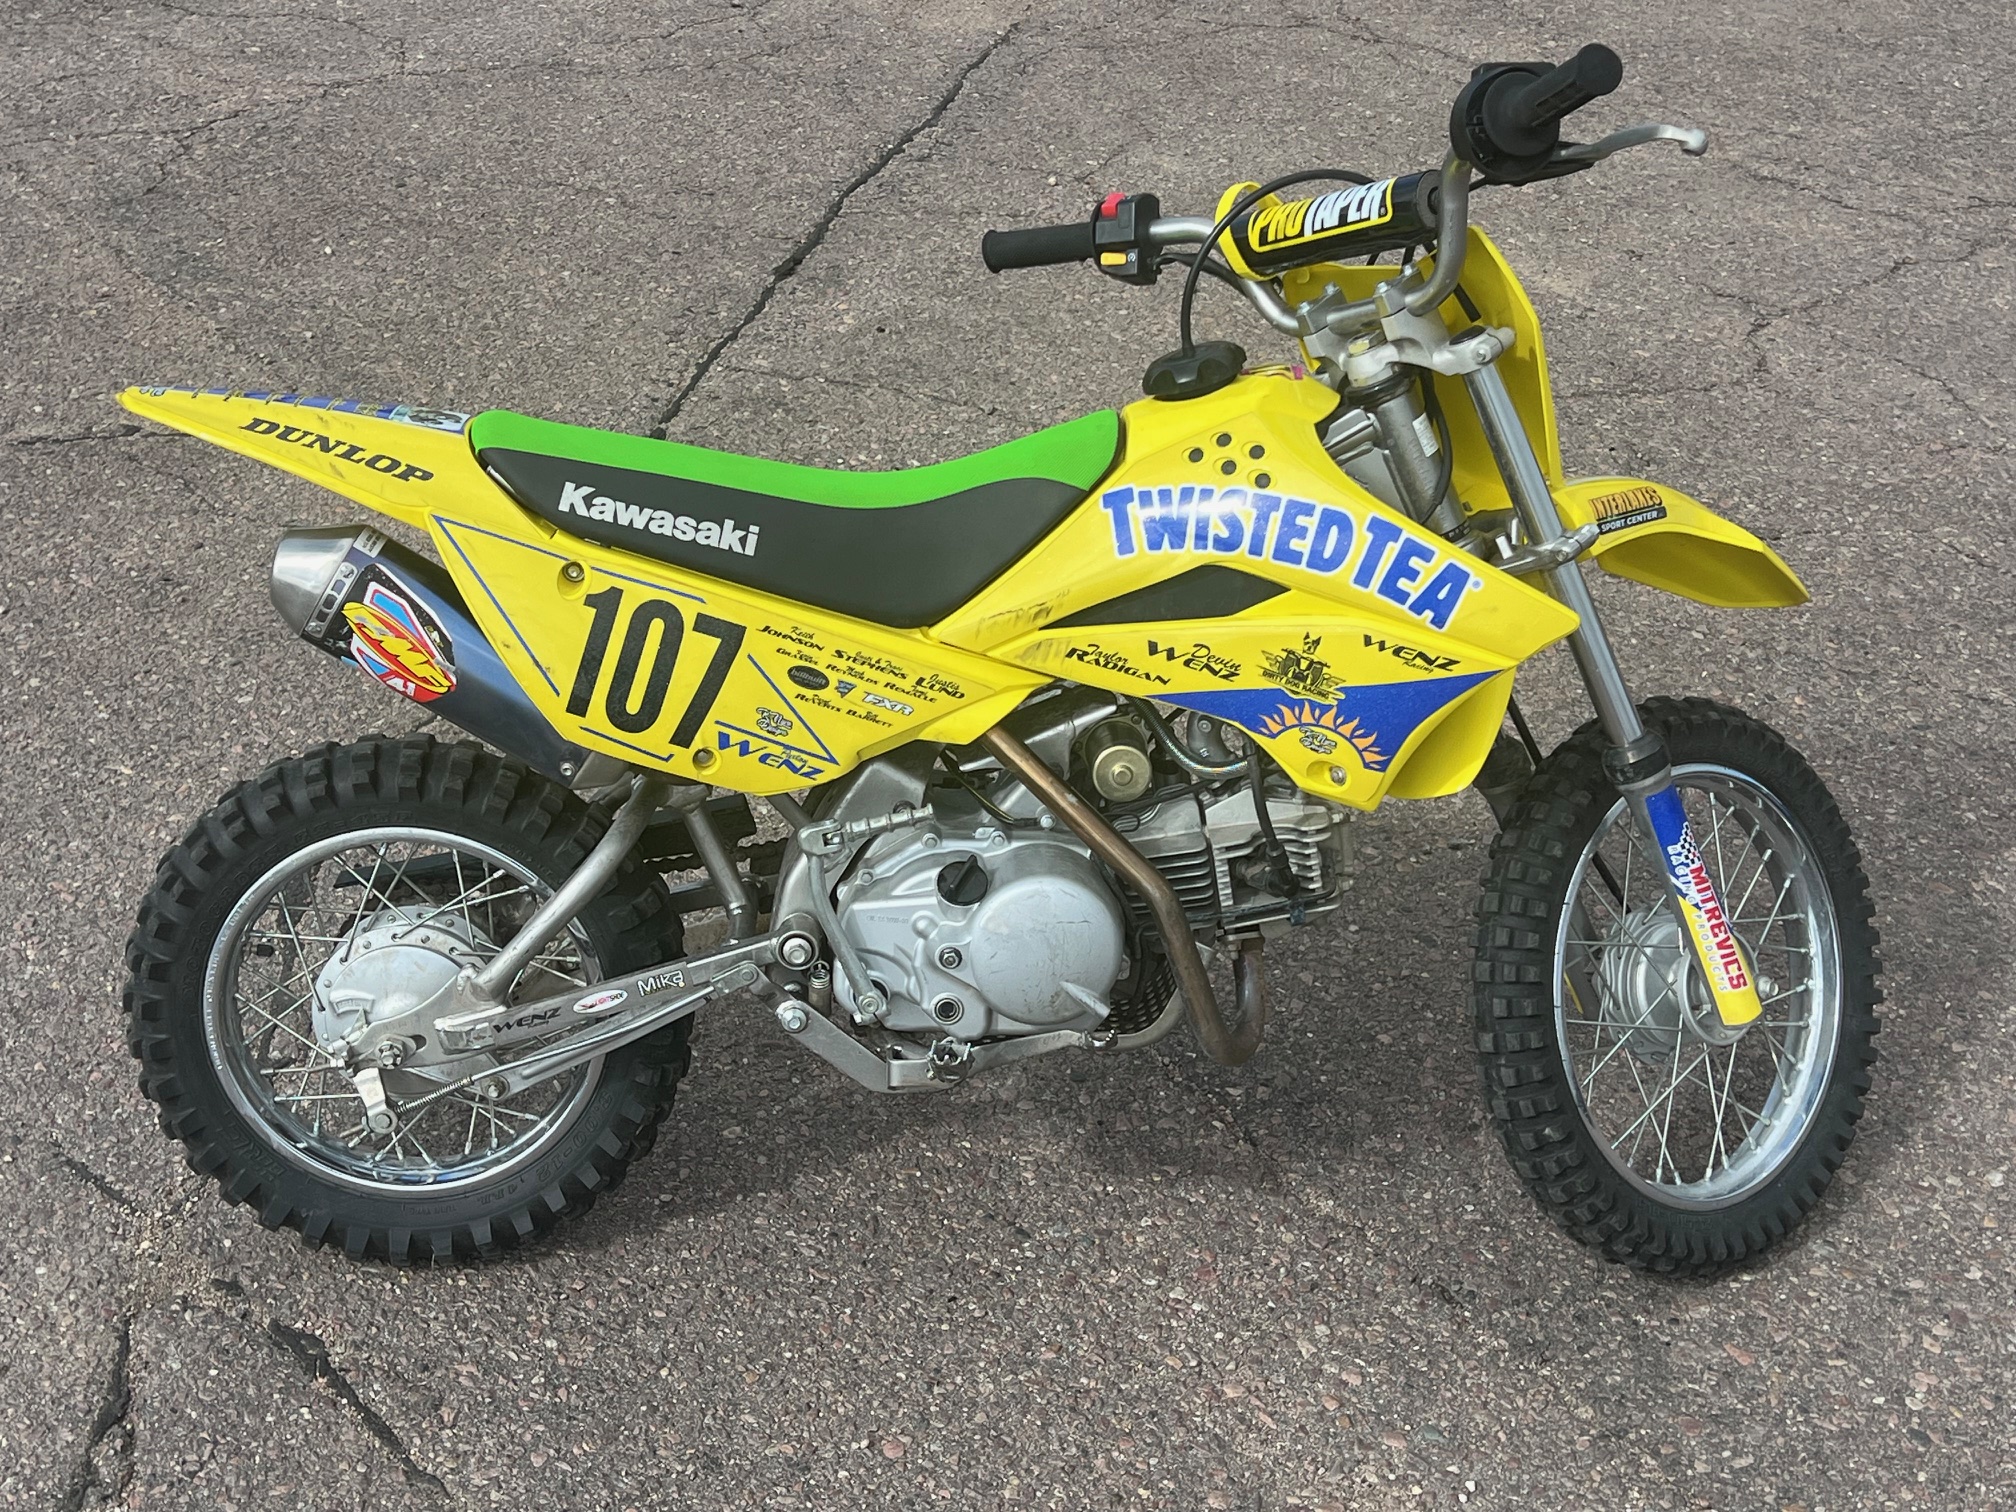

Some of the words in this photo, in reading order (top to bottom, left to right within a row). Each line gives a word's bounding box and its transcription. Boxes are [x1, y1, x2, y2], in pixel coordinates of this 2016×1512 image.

[240, 417, 435, 484] DUNLOP
[558, 481, 760, 557] Kawasaki
[1600, 518, 1626, 533] SPORT
[1626, 510, 1659, 526] CENTER
[1101, 484, 1355, 575] TWISTED
[1352, 514, 1473, 632] TEA
[756, 625, 825, 651] JOHNSON
[1087, 643, 1129, 665] Taylor
[1190, 643, 1242, 672] Devin
[1363, 633, 1461, 672] WENZ
[565, 585, 748, 750] 107
[831, 649, 908, 679] STEPHENS
[1064, 647, 1172, 686] RADIGAN
[1147, 639, 1241, 683] WENZ
[915, 676, 966, 699] LUND
[1261, 670, 1285, 685] DIRTY
[1285, 678, 1302, 690] DOG
[1301, 685, 1330, 699] RACING
[717, 730, 825, 781] WENZ
[1667, 844, 1698, 905] RACING
[1689, 862, 1749, 991] MITREVICS
[1692, 912, 1729, 992] PRODUCTS
[636, 969, 686, 997] Mika
[493, 1006, 562, 1033] WENZ
